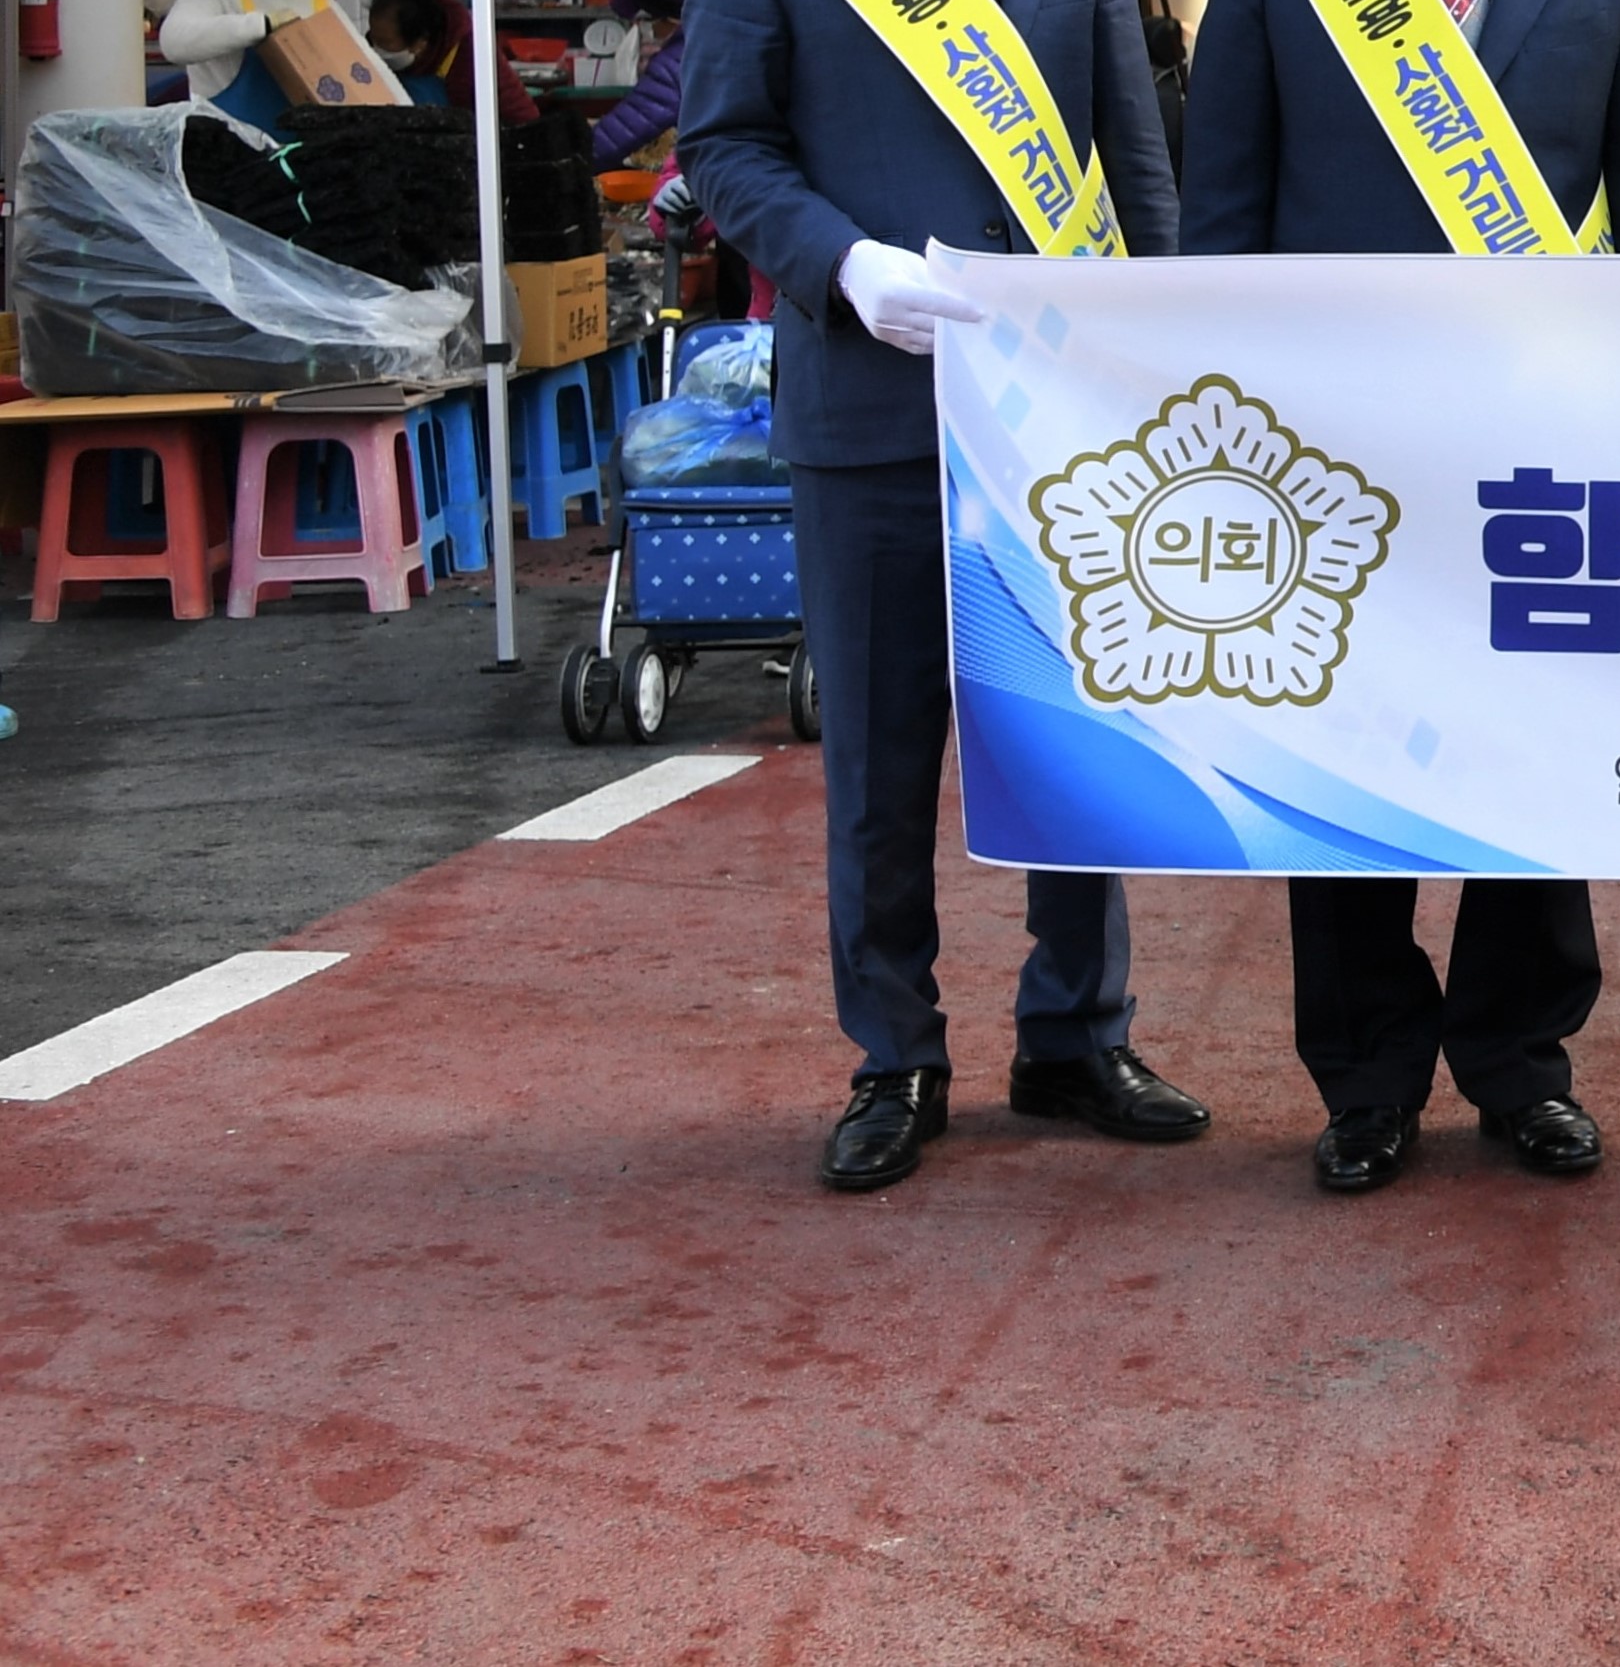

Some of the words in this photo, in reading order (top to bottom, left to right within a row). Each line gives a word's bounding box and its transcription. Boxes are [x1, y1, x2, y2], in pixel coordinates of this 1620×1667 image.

[942, 24, 1037, 135] 사회적
[1394, 42, 1487, 154] 사회적
[1147, 515, 1278, 588] 의회
